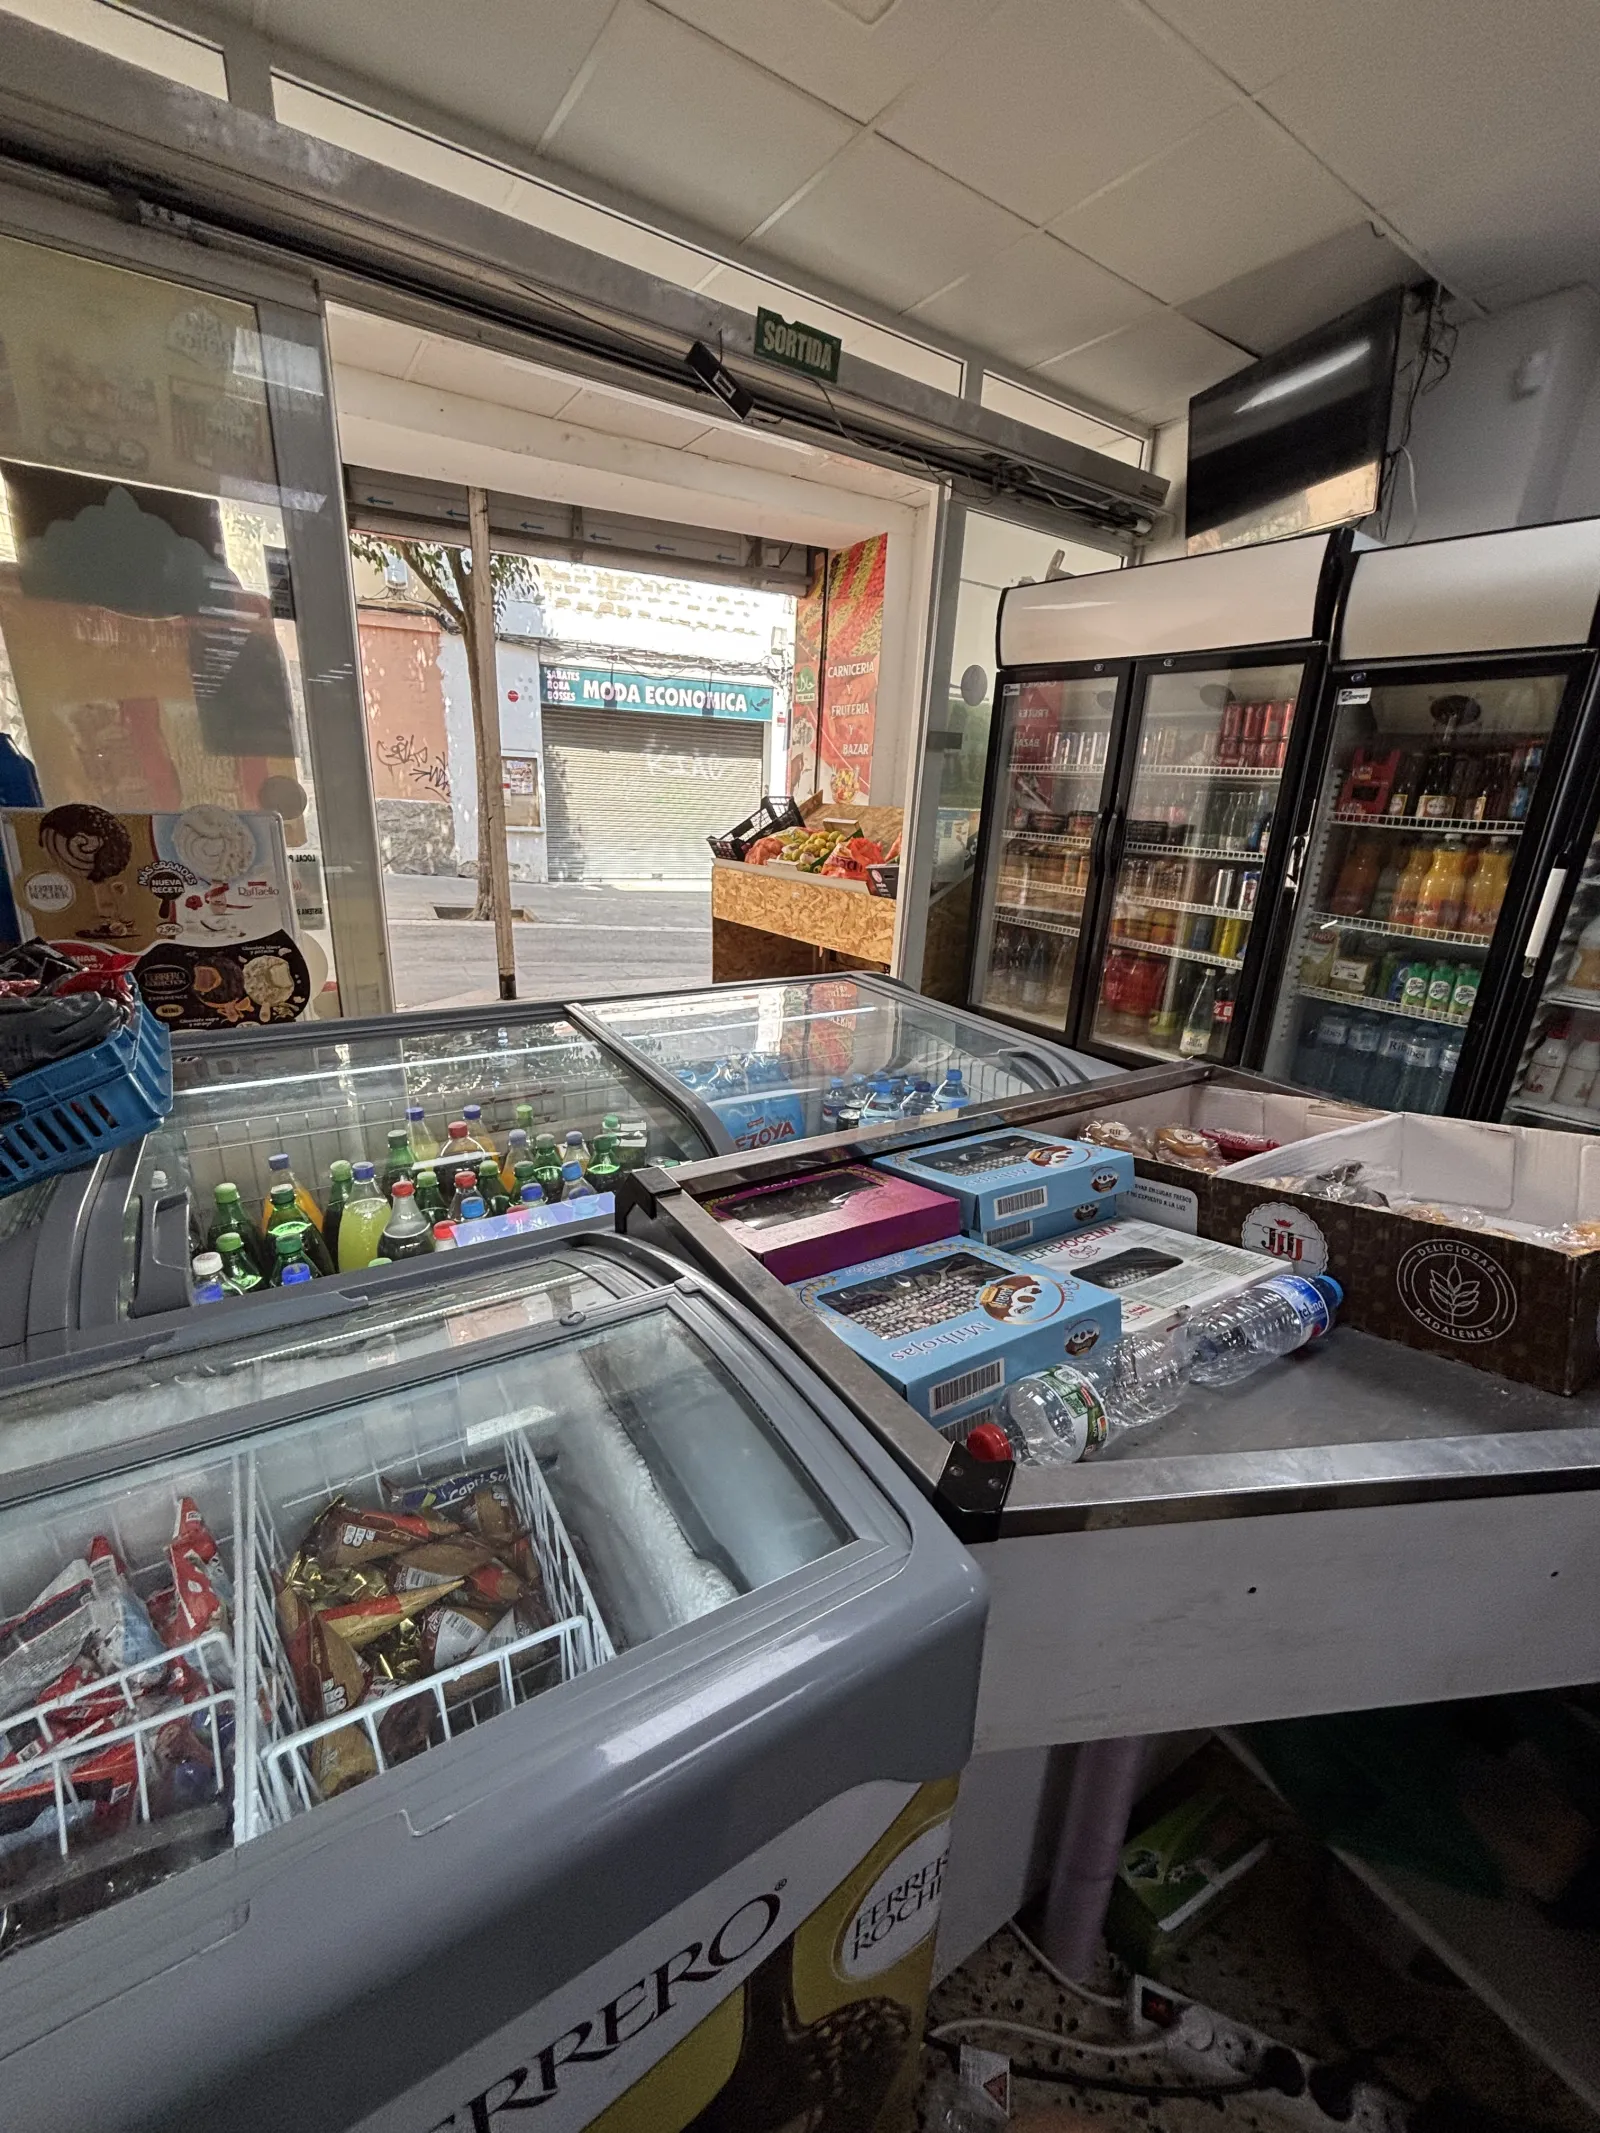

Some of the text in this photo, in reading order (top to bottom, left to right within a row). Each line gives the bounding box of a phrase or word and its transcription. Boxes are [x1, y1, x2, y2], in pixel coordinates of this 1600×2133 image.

[763, 320, 832, 371] SORTIDA
[546, 670, 580, 681] SABATES
[827, 661, 874, 678] CARNICERIA
[547, 690, 576, 701] BOSSES
[583, 680, 748, 713] MODA ECONOMICA
[846, 684, 852, 694] Y
[831, 703, 870, 717] FRUTERIA
[848, 724, 854, 736] Y
[842, 743, 869, 755] BAZAR
[153, 861, 198, 886] GRANDES
[151, 886, 185, 894] RECETA
[238, 886, 280, 897] Raffaello
[735, 1121, 796, 1148] EZOYA
[1417, 1243, 1497, 1273] DELICIOSAS
[1414, 1308, 1493, 1339] MADALENAS
[891, 1321, 993, 1360] Milhojas
[428, 1893, 780, 2133] RRERO
